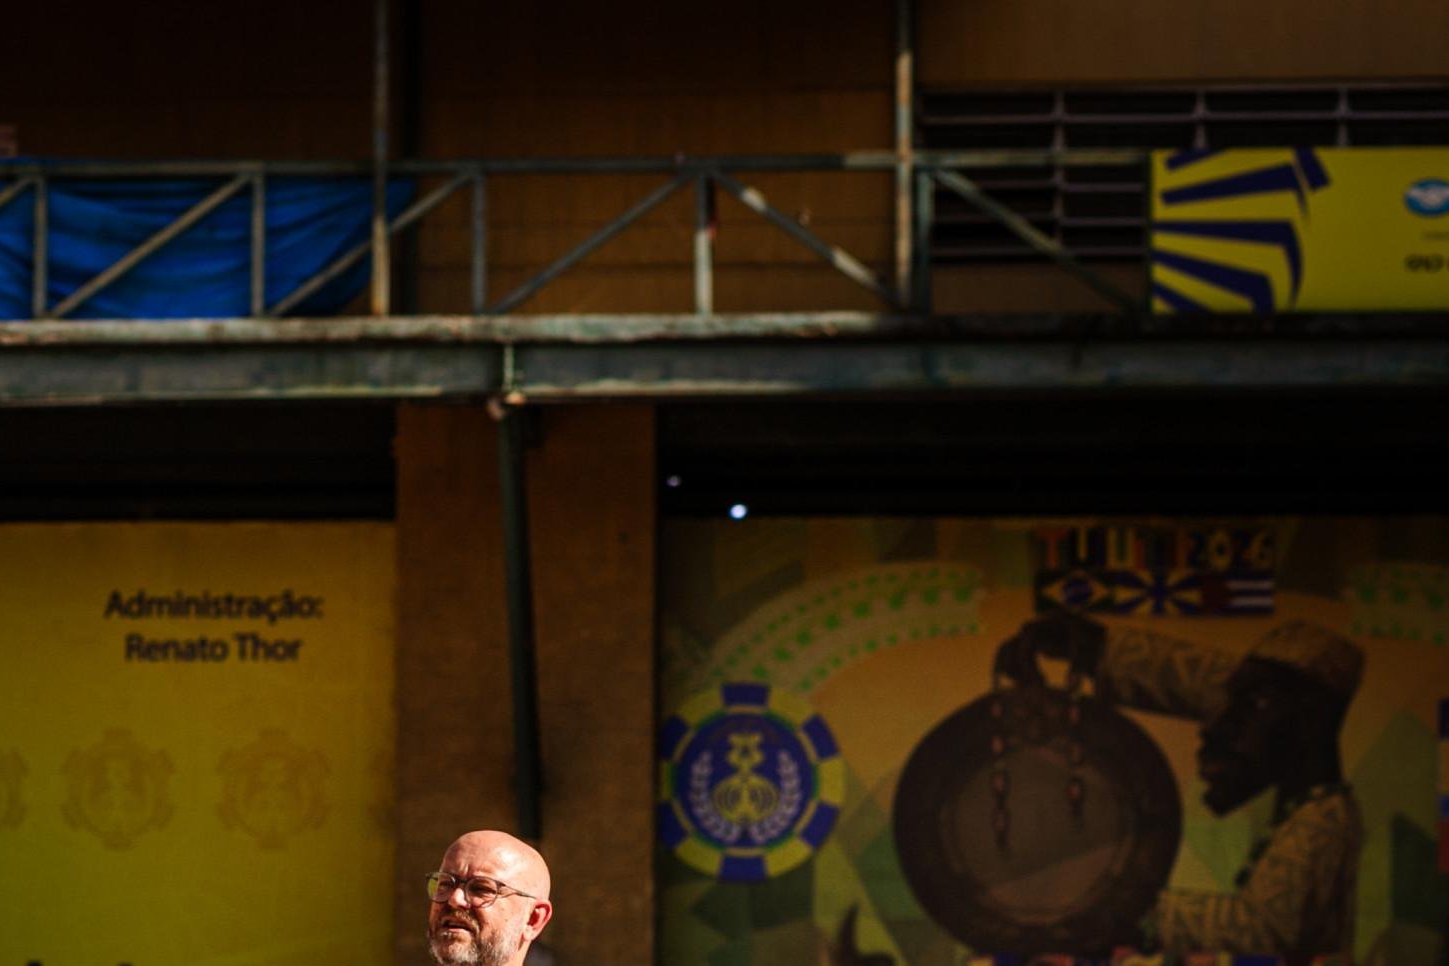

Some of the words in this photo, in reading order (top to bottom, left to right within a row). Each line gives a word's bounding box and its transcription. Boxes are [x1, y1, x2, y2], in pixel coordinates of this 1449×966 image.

[103, 589, 325, 625] Administração:
[124, 633, 230, 662] Renato
[233, 632, 303, 662] Thor
